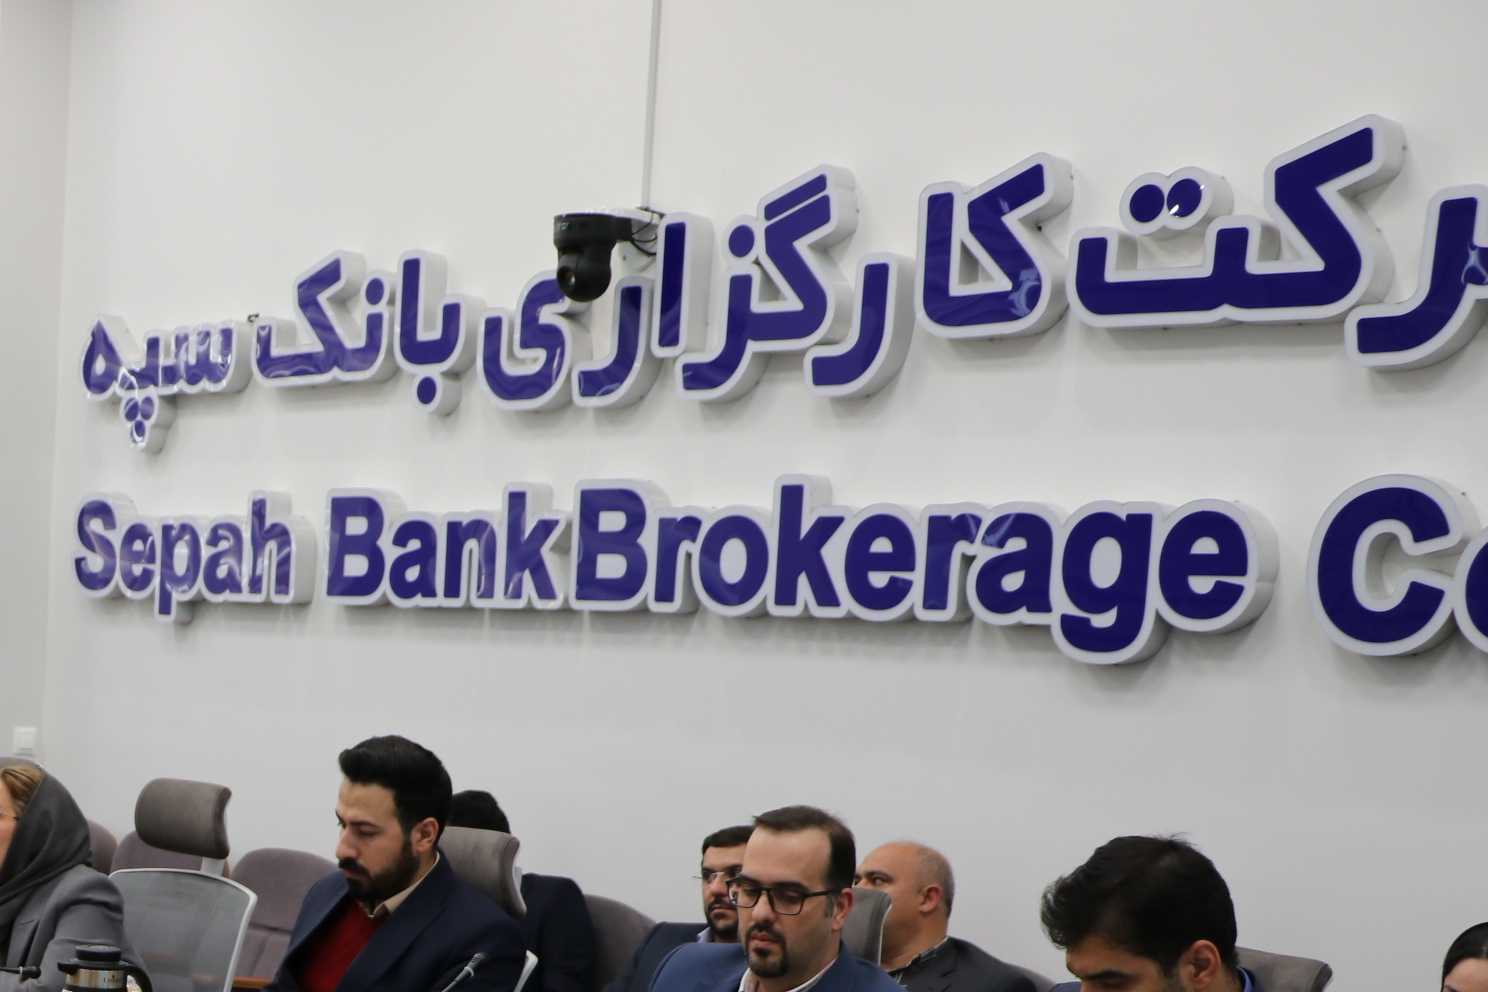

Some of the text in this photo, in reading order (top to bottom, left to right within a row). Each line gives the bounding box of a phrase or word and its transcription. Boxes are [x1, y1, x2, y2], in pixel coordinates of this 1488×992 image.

[1074, 126, 1488, 355] رکت
[82, 326, 238, 437] سپه
[255, 257, 462, 405] بانک
[75, 484, 1488, 654] Sepah Bank Brokerage C
